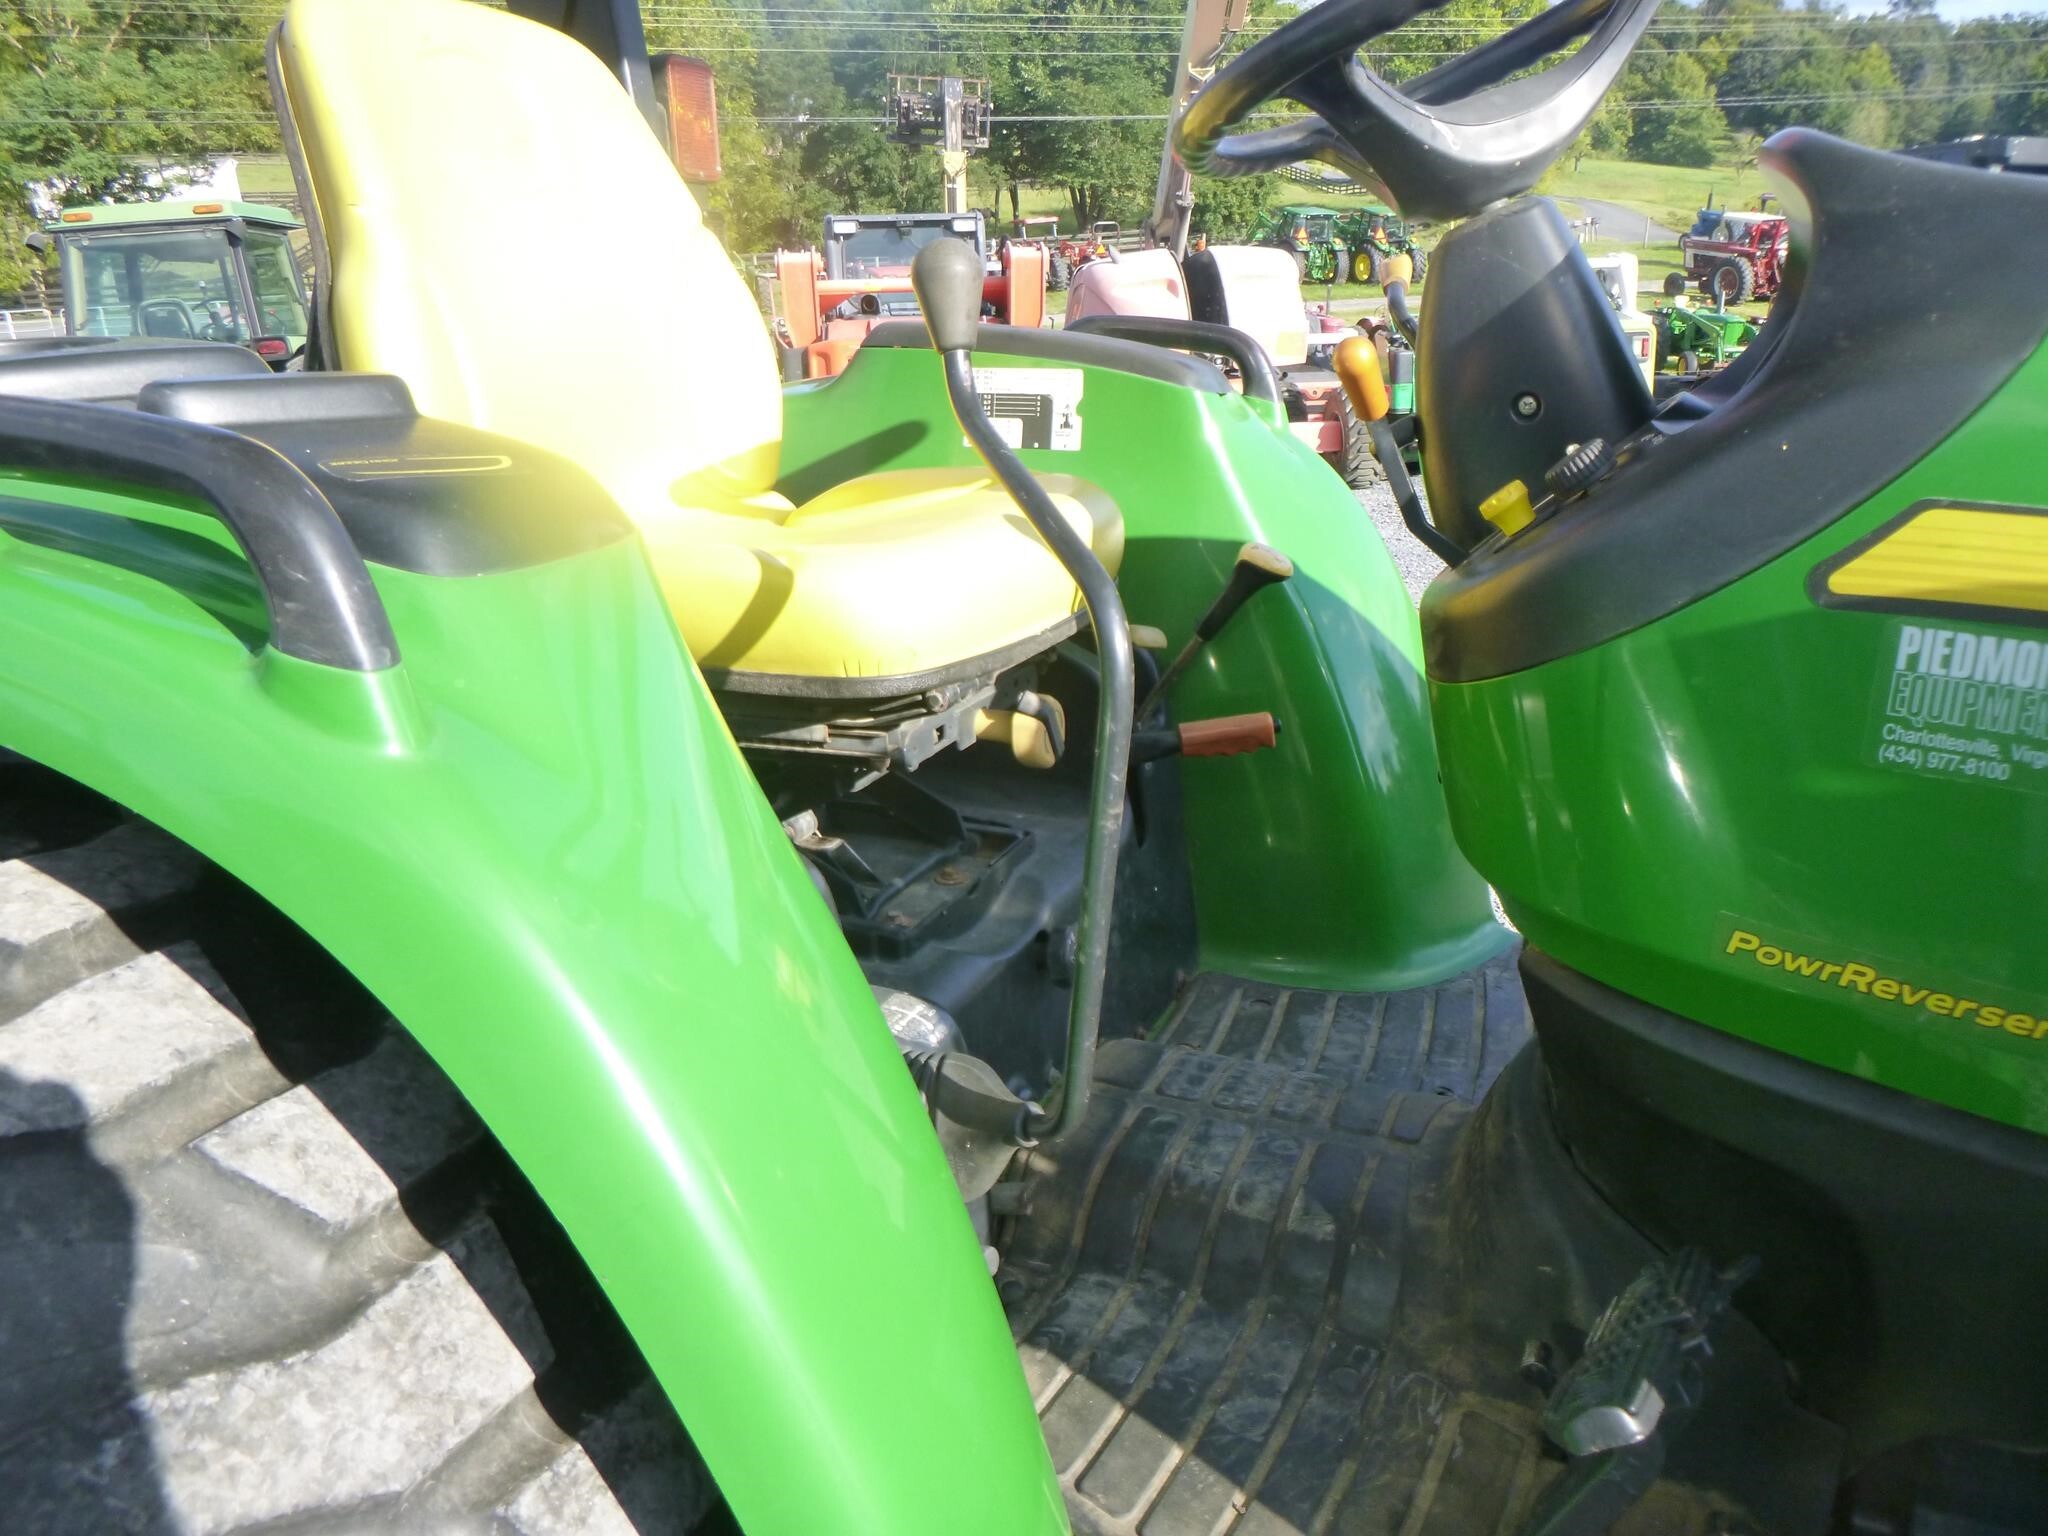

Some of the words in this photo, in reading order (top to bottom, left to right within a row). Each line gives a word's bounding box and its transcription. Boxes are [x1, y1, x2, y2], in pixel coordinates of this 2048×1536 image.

[1882, 723, 2002, 760] Charlottesville,
[1878, 744, 1922, 769] (434)
[1927, 751, 2011, 780] 977-8100
[1725, 929, 2048, 1040] PowrReverser
